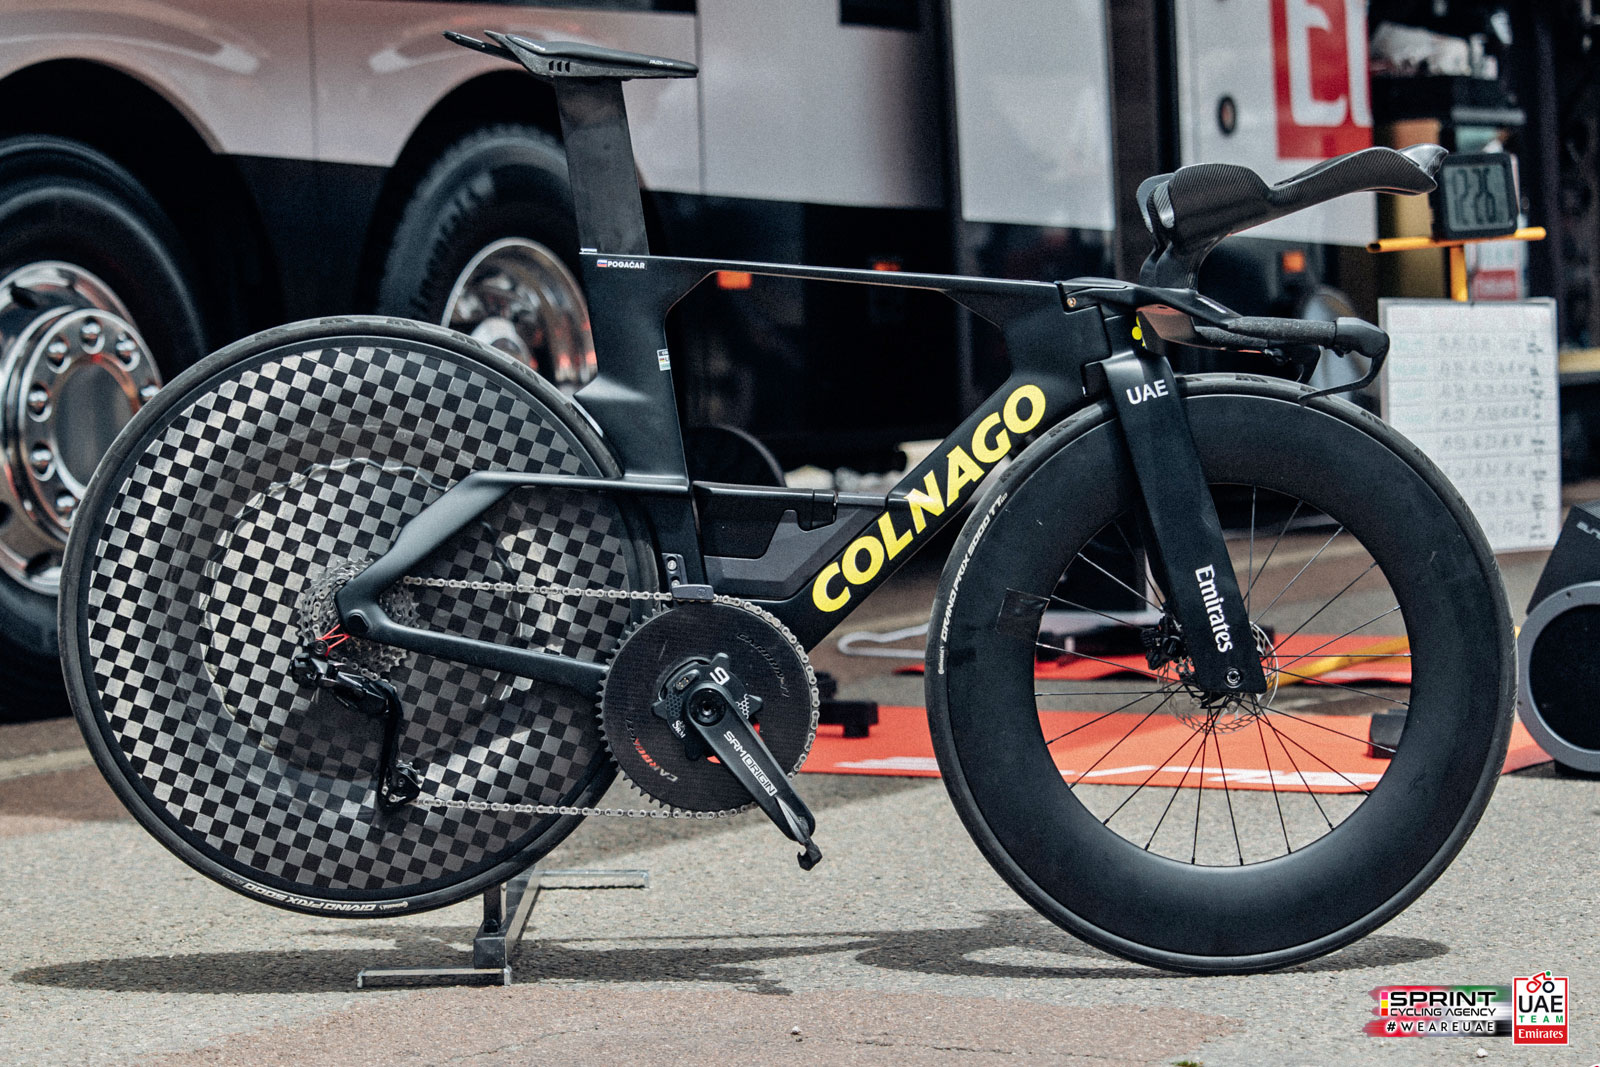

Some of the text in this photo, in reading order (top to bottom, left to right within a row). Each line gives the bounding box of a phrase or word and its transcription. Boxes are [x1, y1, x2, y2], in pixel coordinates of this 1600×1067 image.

[1125, 379, 1169, 405] UAE
[812, 384, 1046, 613] COLNAGO
[941, 591, 958, 642] GRAND
[953, 553, 970, 591] PRIX
[967, 517, 990, 556] 5000
[1194, 564, 1233, 653] Emirates
[723, 730, 777, 796] SRM ORIGIN
[243, 882, 288, 902] 5000
[288, 896, 325, 910] PRIX
[324, 902, 377, 912] GRAND
